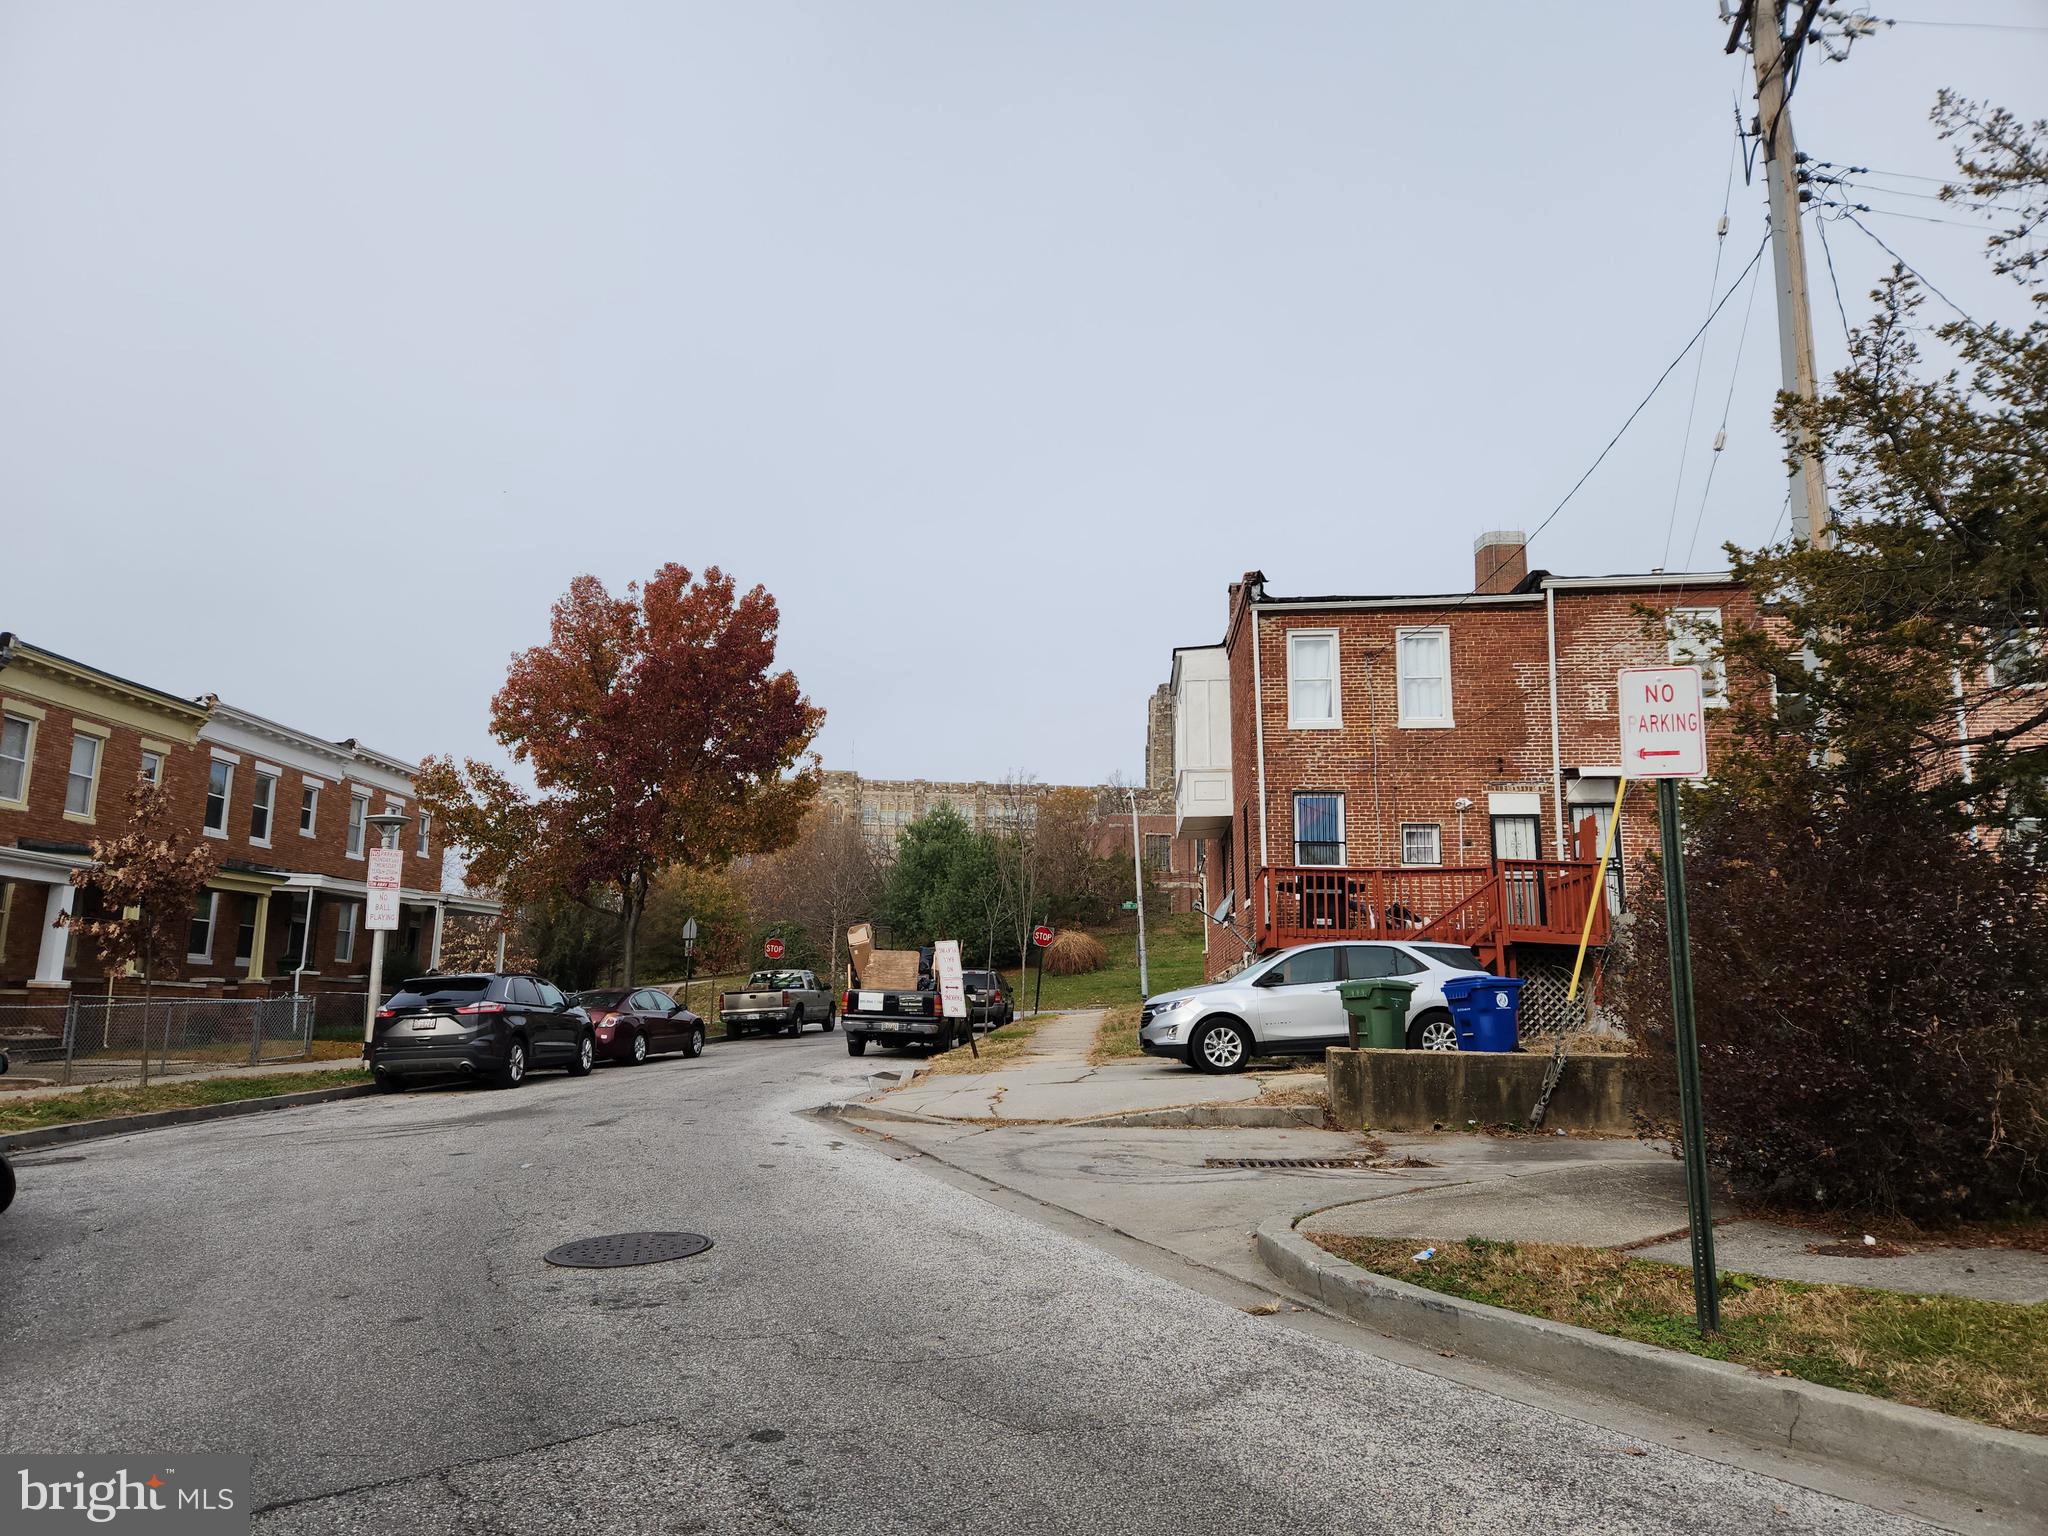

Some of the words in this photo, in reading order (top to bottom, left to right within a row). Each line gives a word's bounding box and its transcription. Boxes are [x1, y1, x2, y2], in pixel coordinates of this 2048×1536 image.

[1645, 684, 1674, 703] NO
[1628, 713, 1697, 733] PARKING
[380, 893, 388, 901] NO
[375, 903, 392, 911] BALL
[369, 913, 395, 921] PLAYING
[1034, 931, 1053, 942] STOP
[766, 944, 784, 953] STOP
